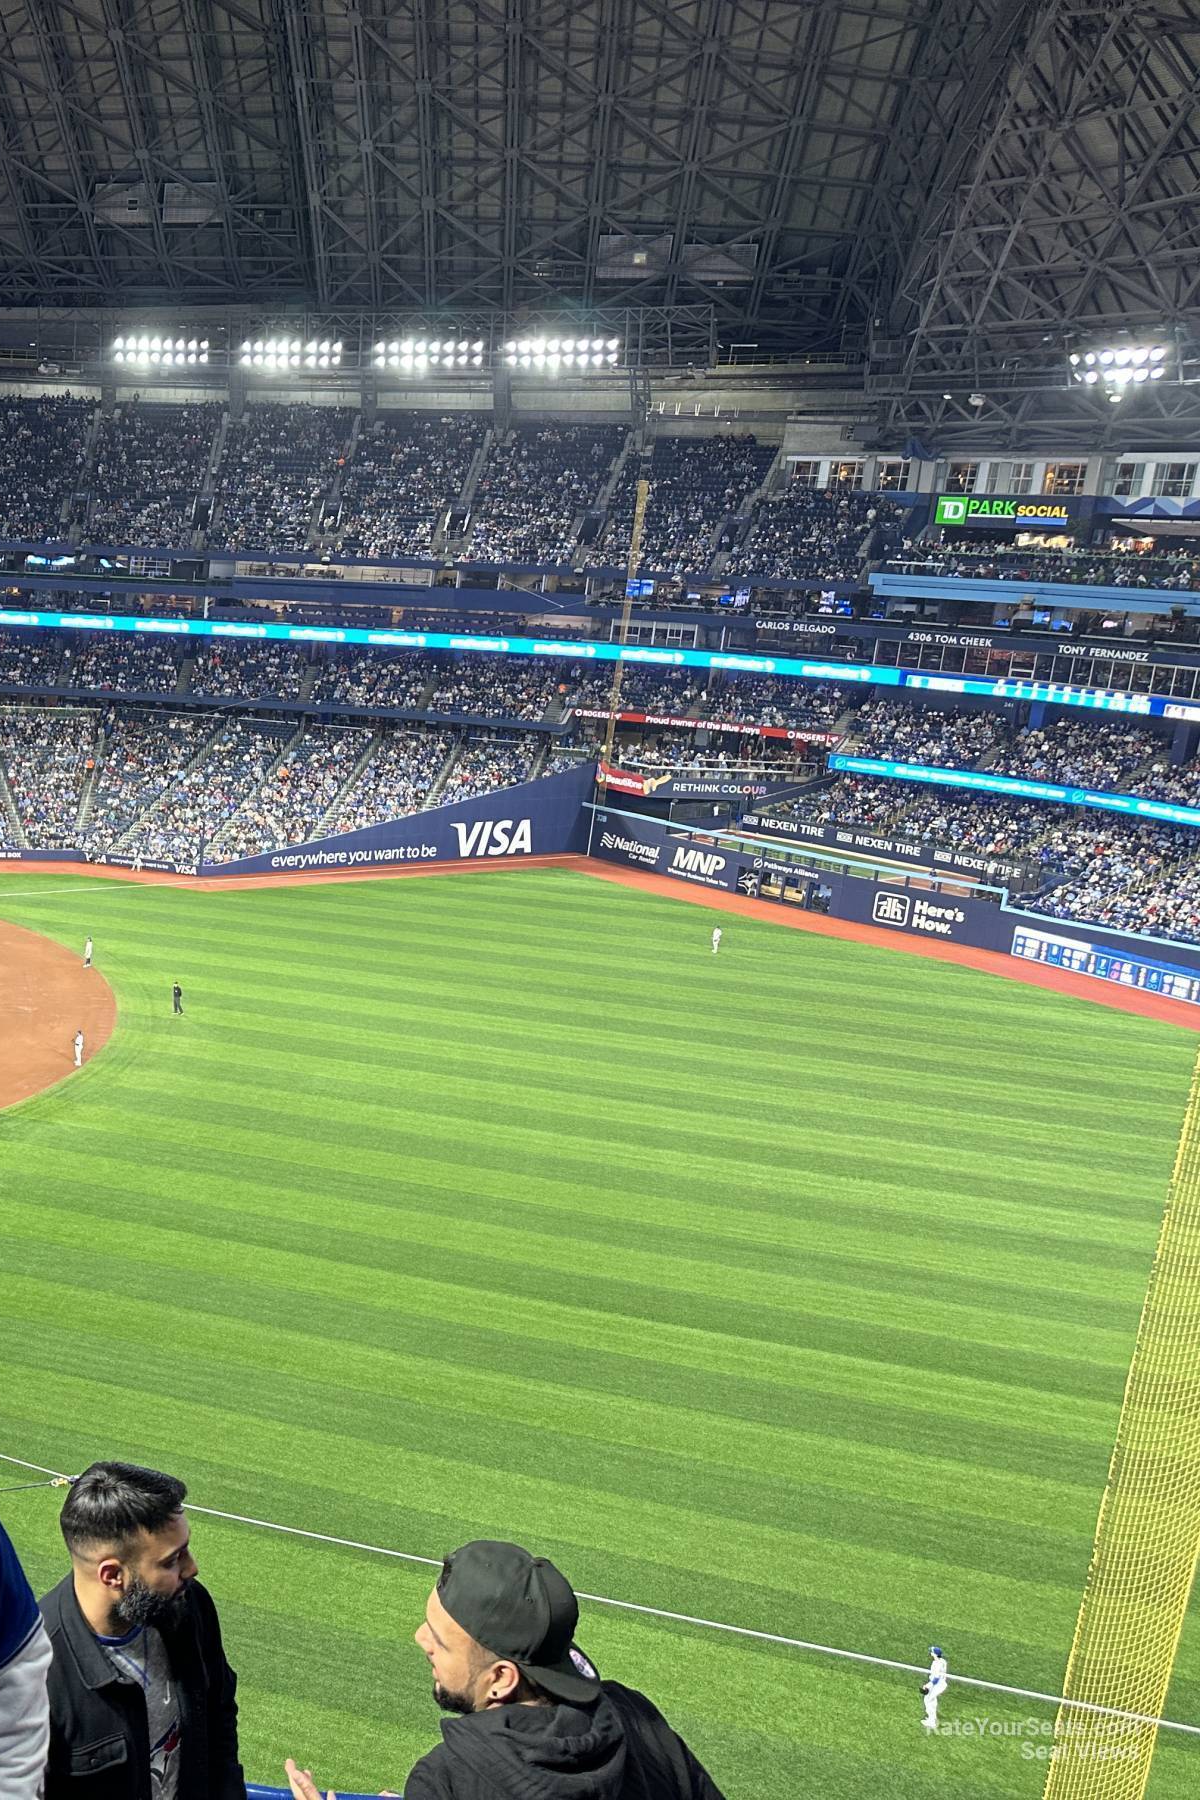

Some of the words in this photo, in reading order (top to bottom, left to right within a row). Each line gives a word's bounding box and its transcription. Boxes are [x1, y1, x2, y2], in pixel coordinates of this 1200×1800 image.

[941, 502, 964, 519] TD
[968, 501, 1016, 515] PARK
[1017, 505, 1069, 518] SOCIAL
[756, 620, 790, 631] CARLOS
[793, 624, 836, 634] DELGADO
[908, 631, 932, 642] 4306
[934, 634, 957, 644] TOM
[960, 637, 993, 647] CHEEK
[1058, 645, 1086, 656] TONY
[1089, 648, 1150, 662] FERNANDEZ
[583, 711, 610, 720] ROGERS
[645, 715, 670, 726] Proud
[670, 718, 696, 728] owner
[707, 721, 720, 731] the
[721, 723, 740, 733] Blue
[740, 725, 760, 736] Jays
[795, 731, 826, 743] ROGERS
[673, 782, 720, 793] RETHINK
[722, 784, 767, 795] COLOUR
[761, 815, 798, 833] NEXEN
[800, 824, 825, 838] TIRE
[450, 819, 532, 858] VISA
[855, 835, 894, 851] NEXEN
[895, 841, 921, 857] TIRE
[271, 850, 347, 868] everywhere
[348, 848, 372, 865] you
[374, 847, 405, 862] want
[406, 847, 419, 859] to
[421, 844, 437, 858] be
[672, 847, 727, 876] MNP
[174, 864, 197, 875] VISA
[764, 861, 793, 873] Pathways
[793, 865, 819, 879] Alliance
[914, 899, 965, 923] Here's
[912, 914, 952, 935] How.
